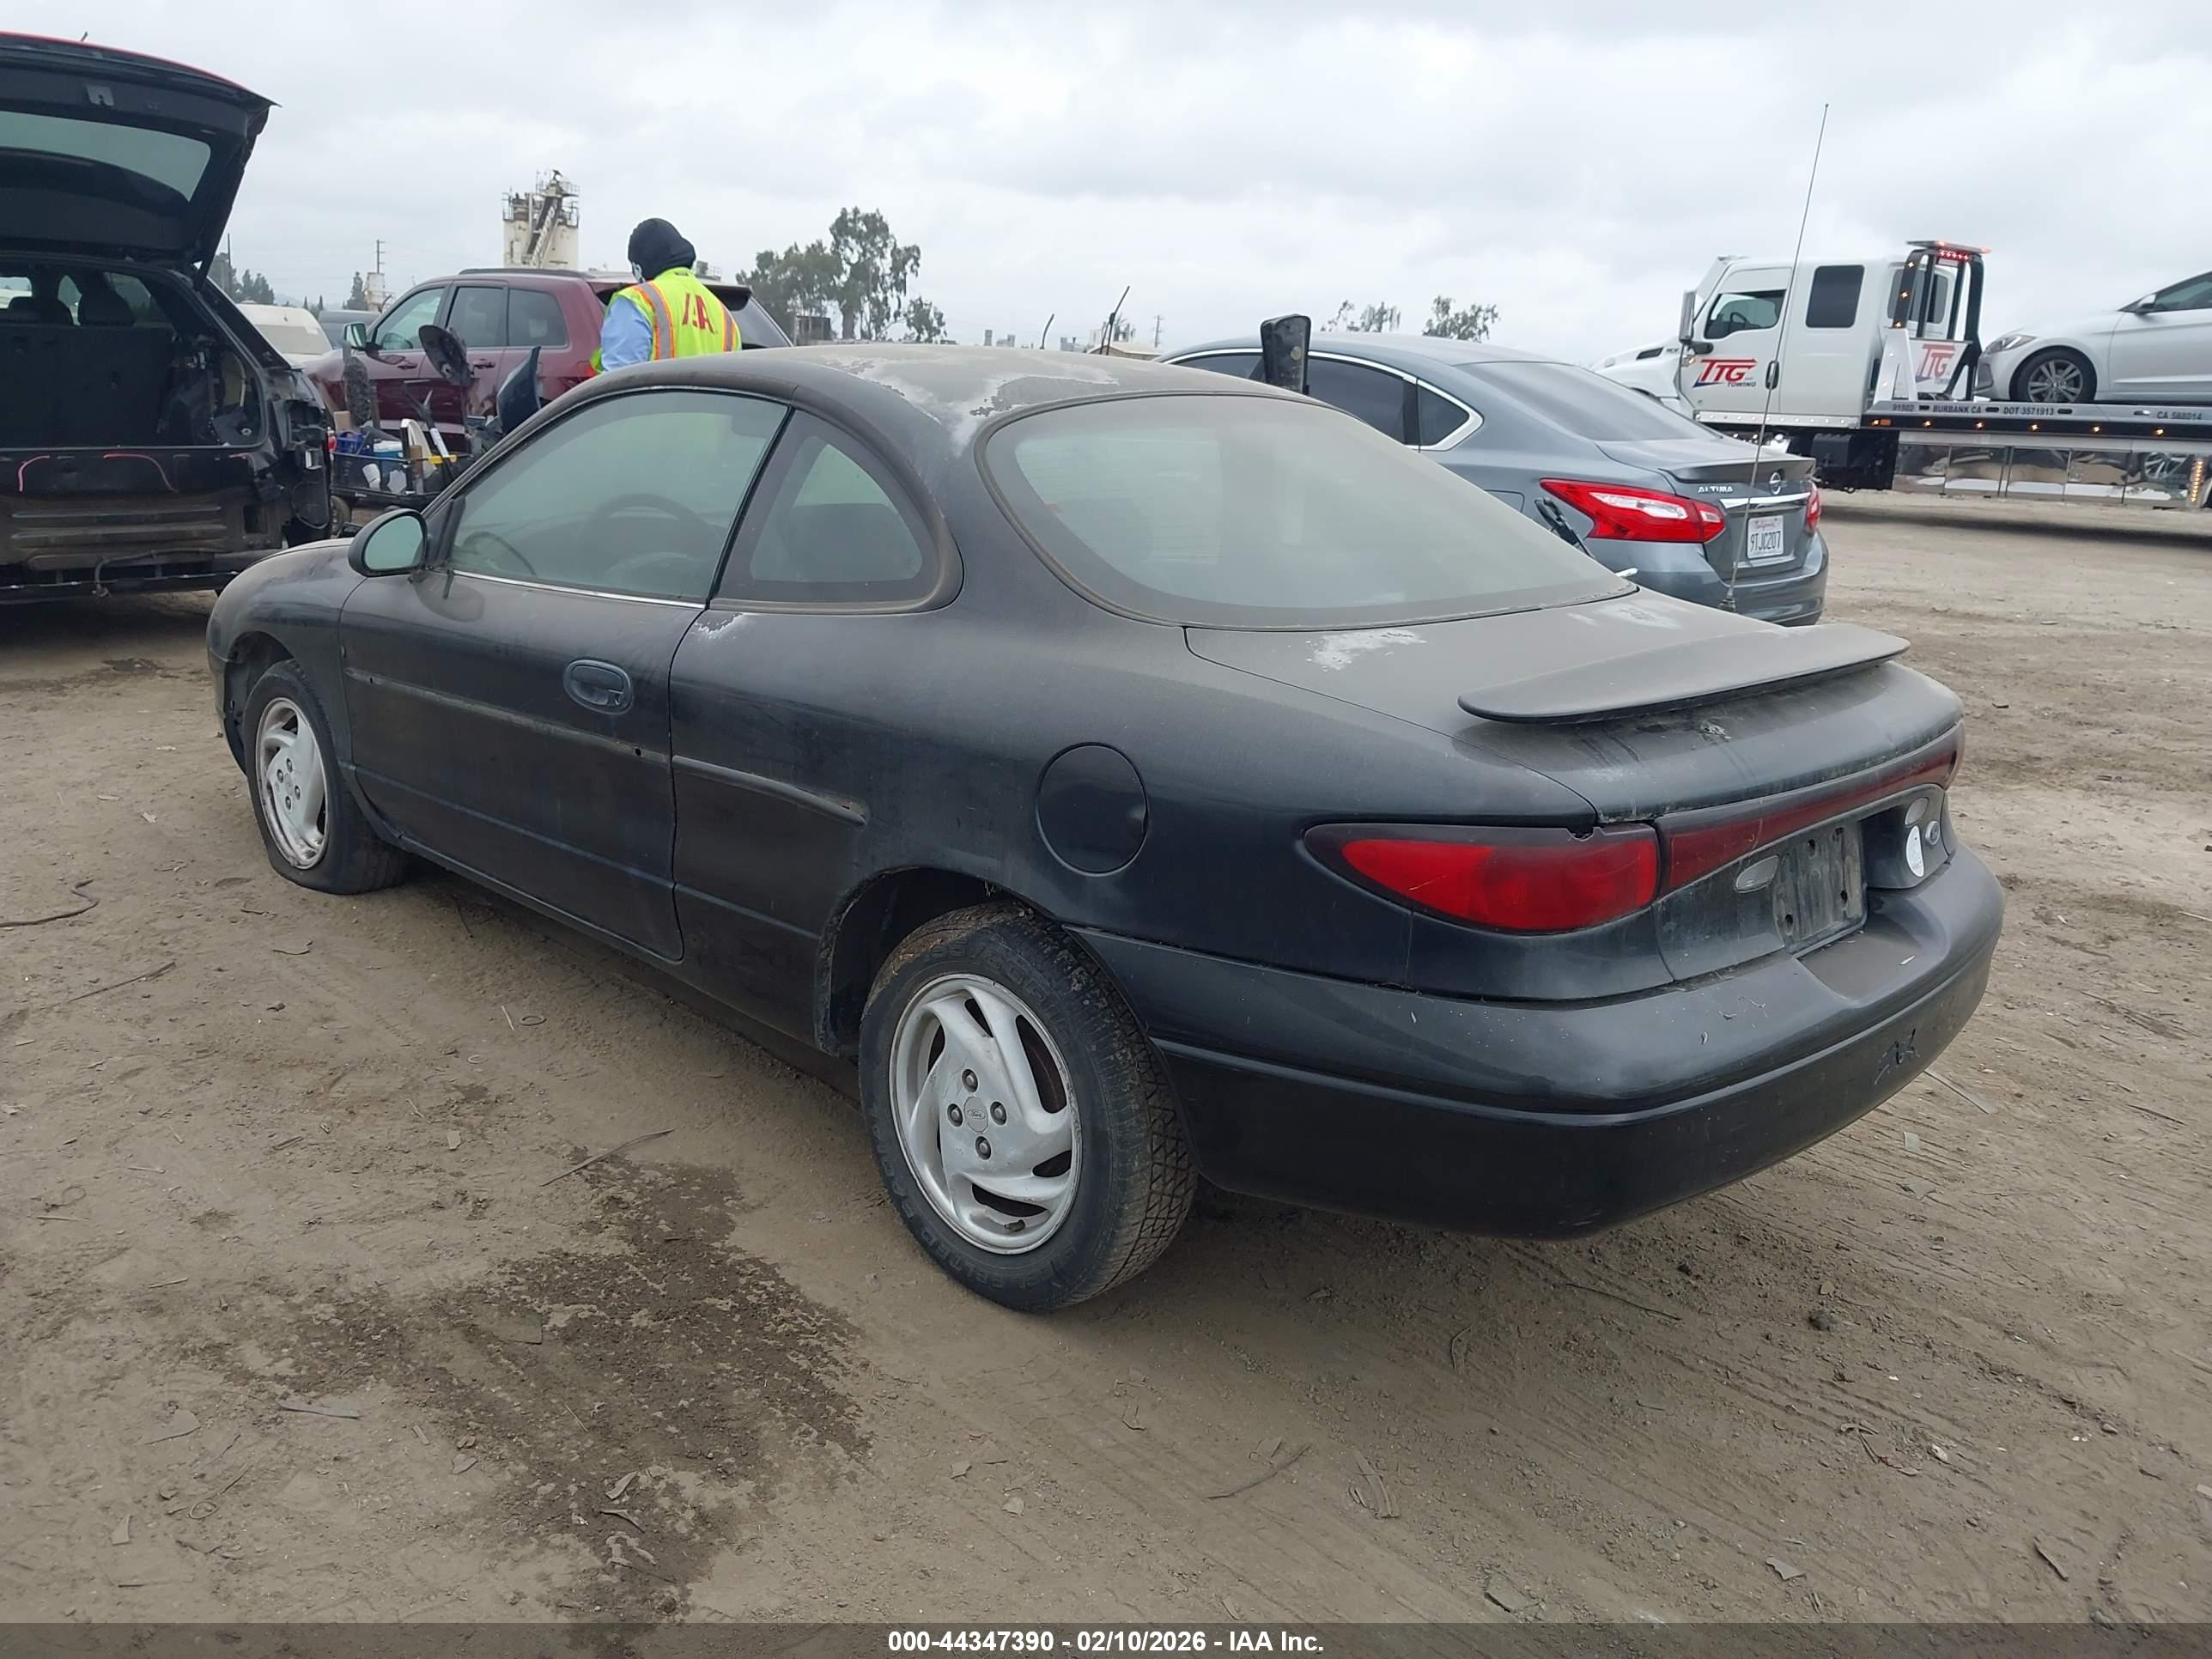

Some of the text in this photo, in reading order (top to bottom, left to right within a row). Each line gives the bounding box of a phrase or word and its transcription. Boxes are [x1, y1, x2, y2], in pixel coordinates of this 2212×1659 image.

[1700, 358, 1757, 382] TTG
[1919, 343, 1955, 378] TTG
[2002, 406, 2019, 415] DOT
[2157, 410, 2168, 419] CA
[1750, 530, 1781, 551] 9TJC207
